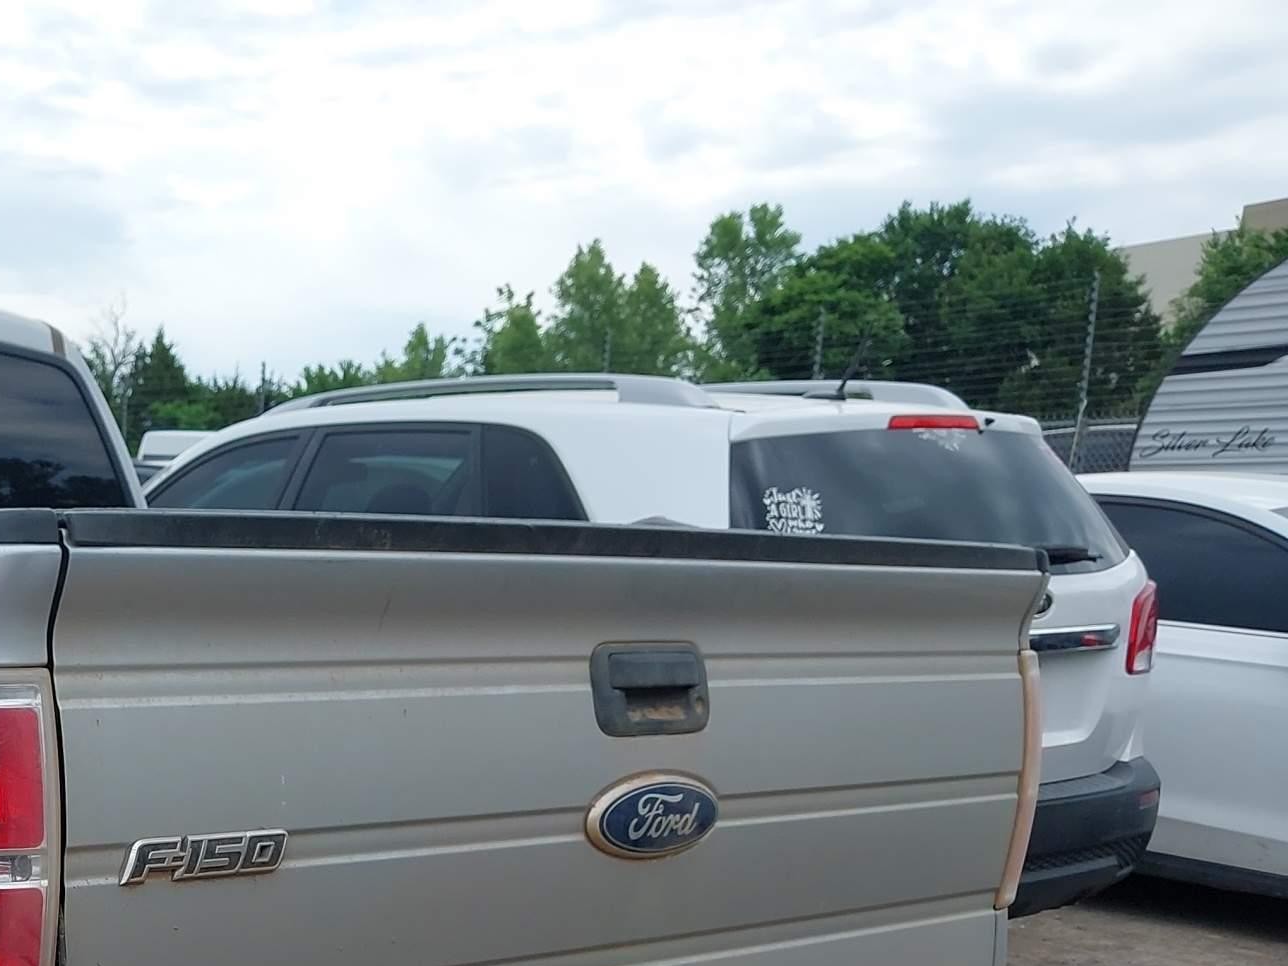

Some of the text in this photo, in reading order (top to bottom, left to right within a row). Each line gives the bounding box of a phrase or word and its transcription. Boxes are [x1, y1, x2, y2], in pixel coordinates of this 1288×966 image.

[1212, 425, 1276, 458] Lake
[628, 793, 700, 840] Ford
[119, 828, 289, 886] F-150
